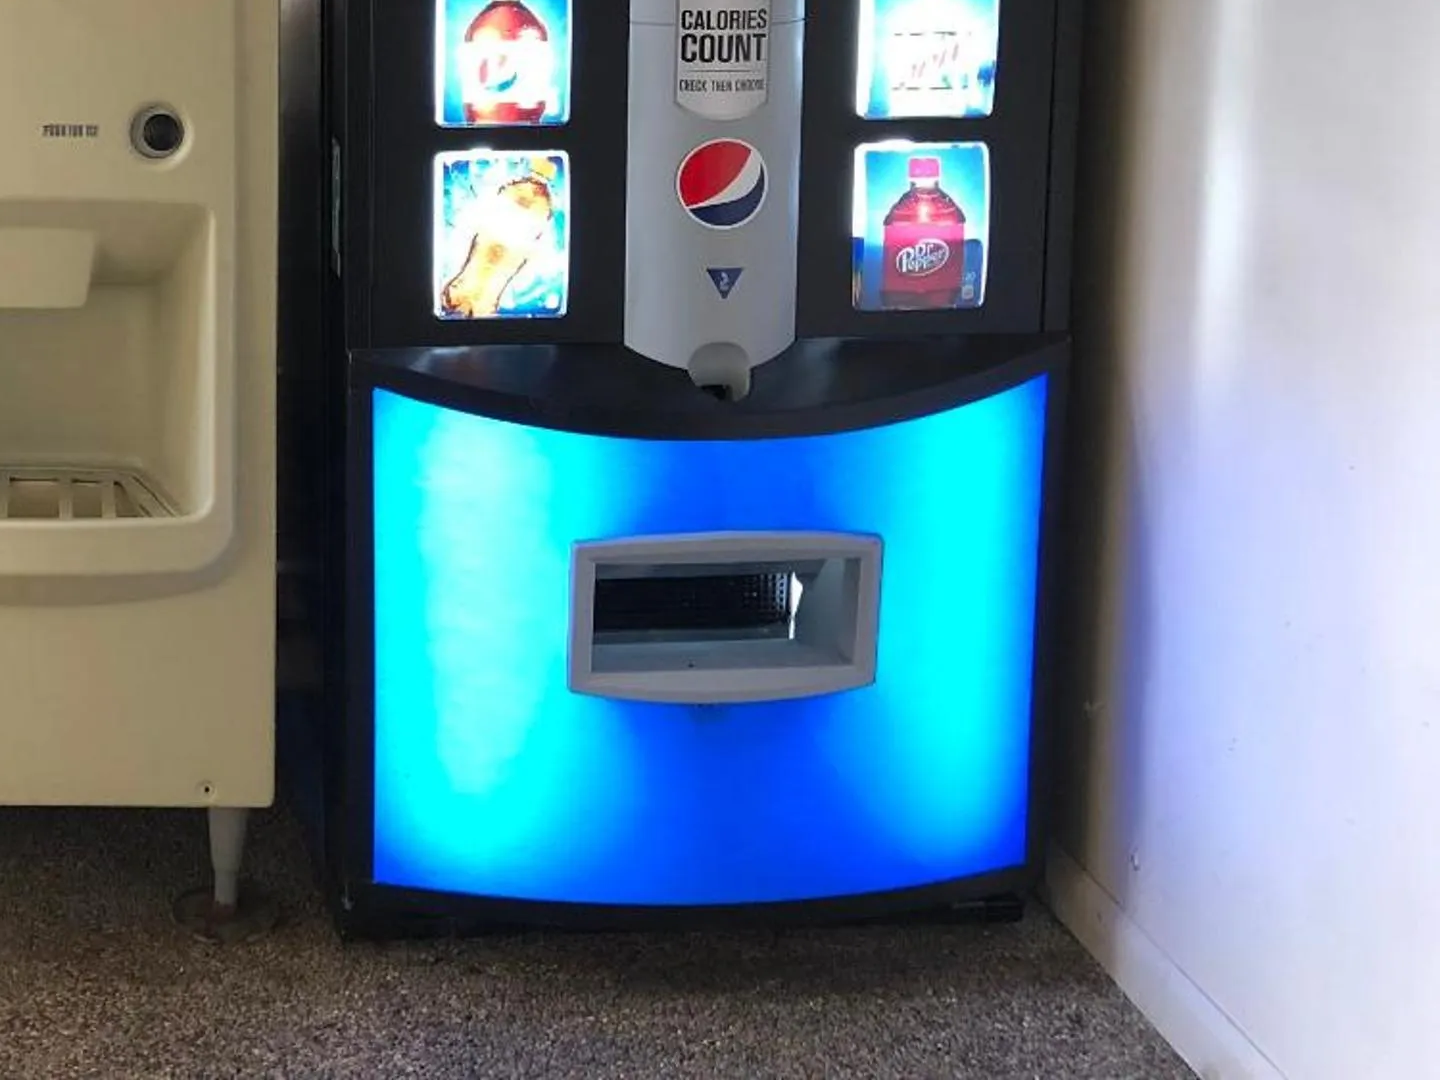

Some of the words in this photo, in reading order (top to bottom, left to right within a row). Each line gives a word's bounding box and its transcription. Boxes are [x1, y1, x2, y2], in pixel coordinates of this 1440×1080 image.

[680, 8, 768, 30] CALORIES
[680, 33, 767, 63] COUNT
[679, 79, 707, 92] CHECK
